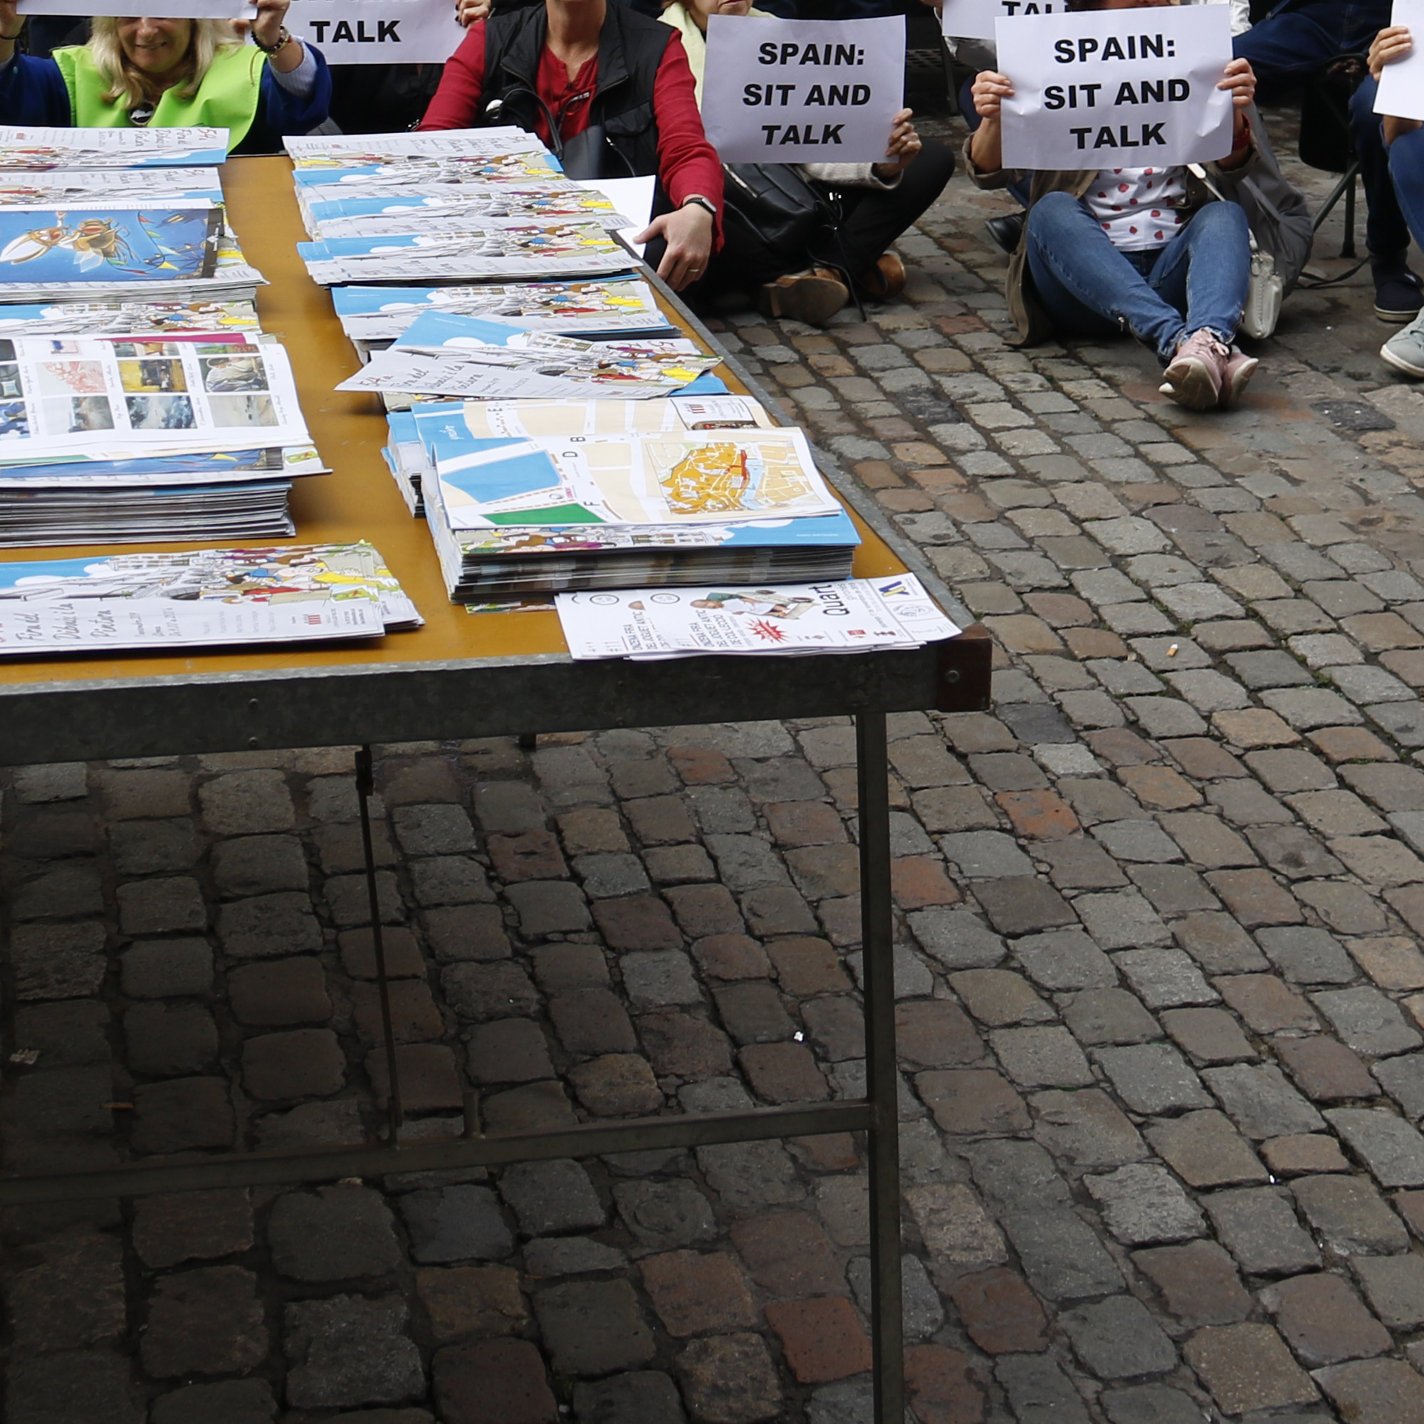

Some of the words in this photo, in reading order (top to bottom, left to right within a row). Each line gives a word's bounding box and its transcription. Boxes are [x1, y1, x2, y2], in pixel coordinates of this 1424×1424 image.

[310, 21, 401, 43] TALK
[758, 43, 864, 65] SPAIN:
[1055, 34, 1175, 63] SPAIN:
[743, 84, 795, 106] SIT
[804, 85, 870, 106] AND
[1044, 84, 1101, 110] SIT
[1114, 79, 1190, 105] AND
[762, 124, 845, 145] TALK
[1070, 123, 1166, 149] TALK
[808, 583, 851, 617] Quart
